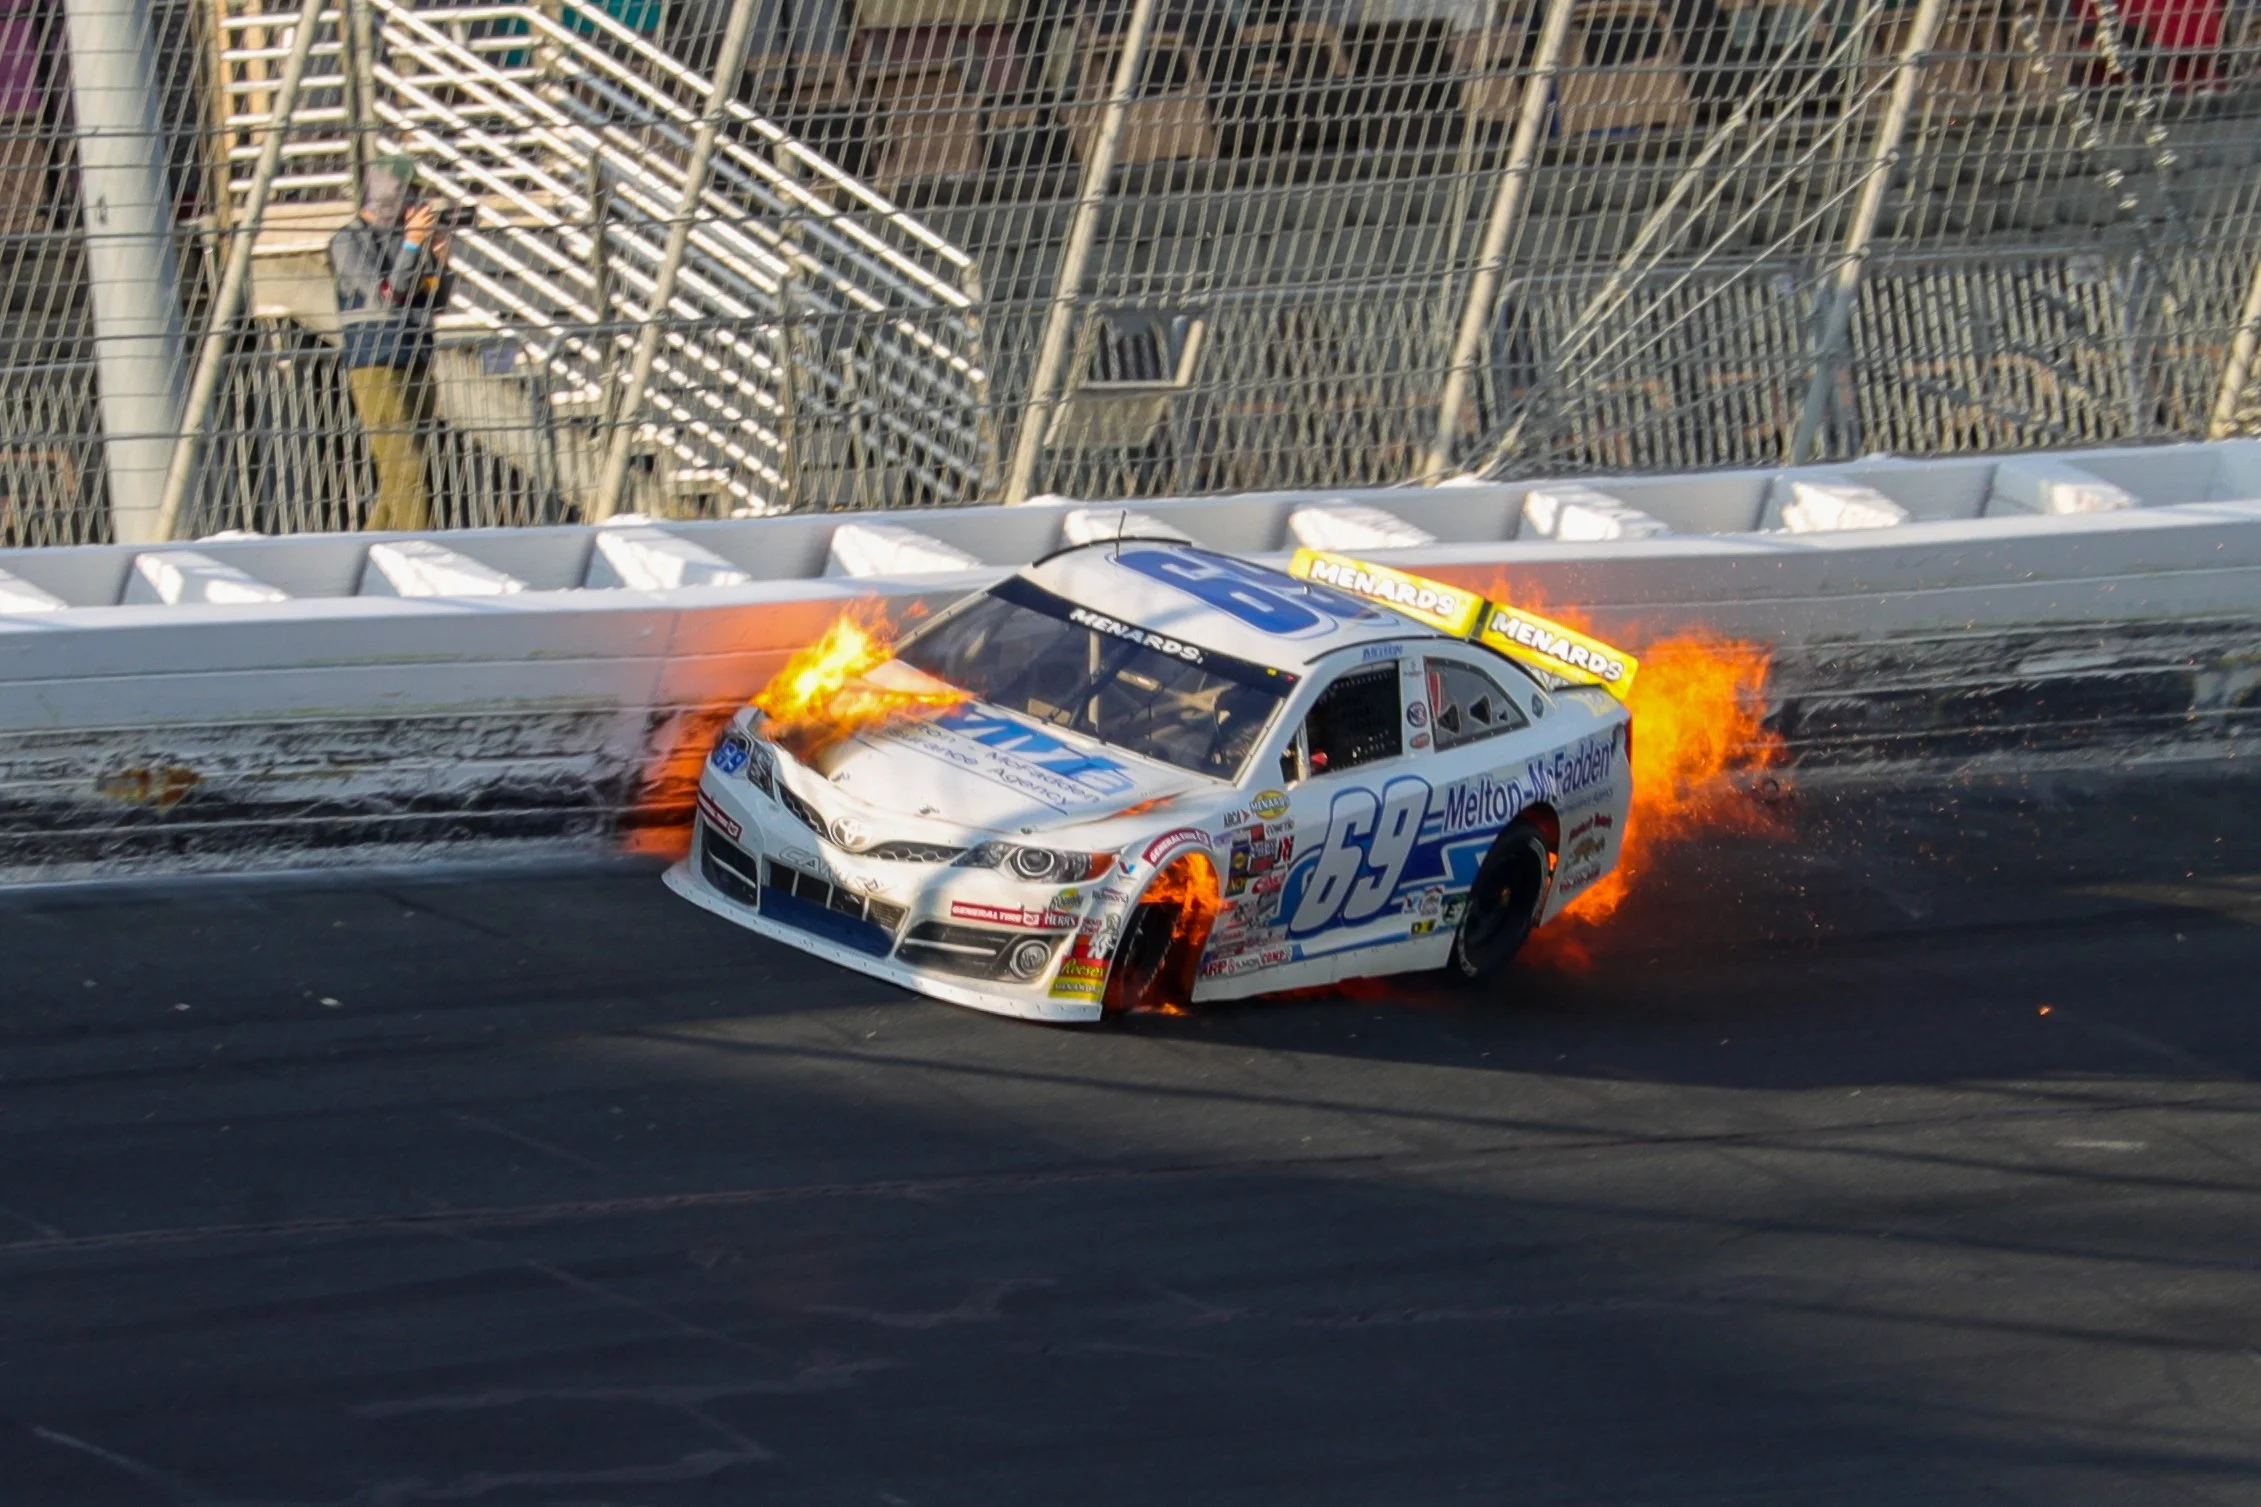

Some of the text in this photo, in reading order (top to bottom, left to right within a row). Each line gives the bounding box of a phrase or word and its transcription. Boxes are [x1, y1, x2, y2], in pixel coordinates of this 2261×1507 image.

[1310, 559, 1458, 616] MENARDS
[1069, 609, 1201, 662] MENARDS
[1491, 612, 1626, 682] MENARDS
[1289, 775, 1433, 938] 69
[952, 905, 998, 920] GENERAL
